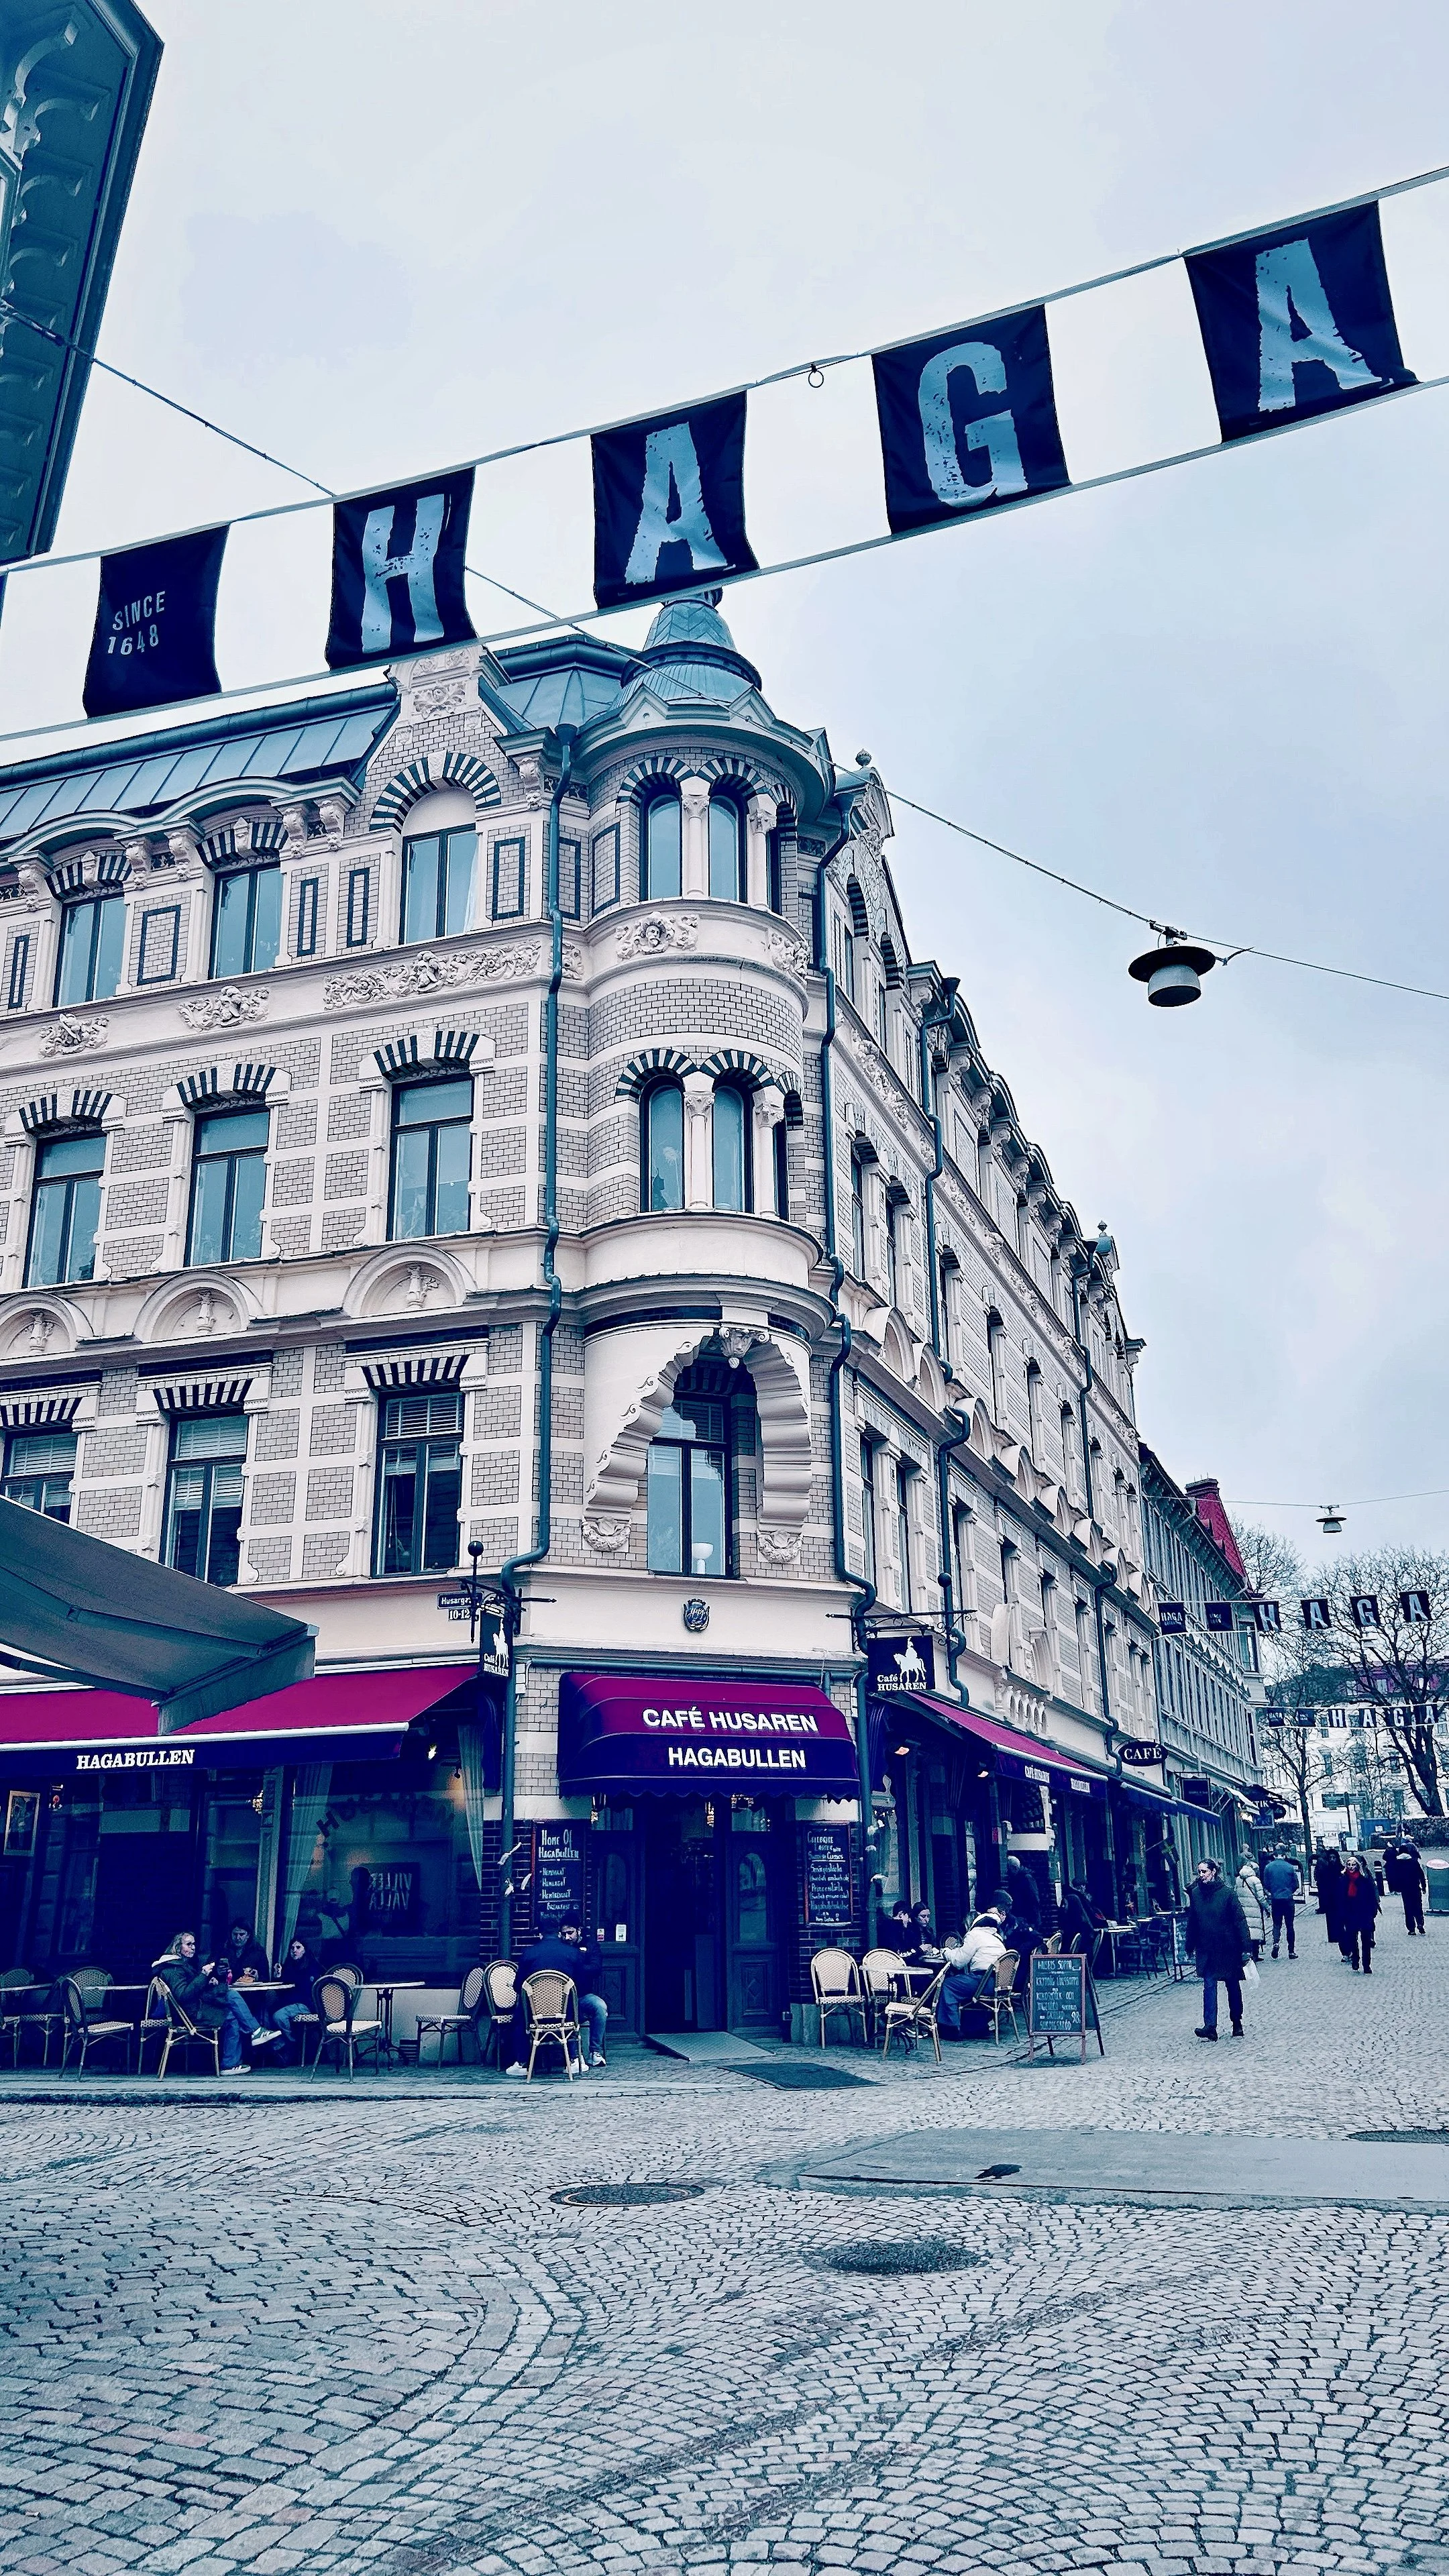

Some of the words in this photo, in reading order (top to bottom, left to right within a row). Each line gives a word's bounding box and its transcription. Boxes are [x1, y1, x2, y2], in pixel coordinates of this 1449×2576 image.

[113, 590, 166, 631] SINCE
[107, 624, 160, 656] 1648
[449, 1609, 470, 1620] 10-12
[877, 1673, 898, 1682] Café
[877, 1682, 926, 1691] HUSAREN
[643, 1706, 705, 1728] CAFÉ
[708, 1711, 818, 1732] HUSAREN
[76, 1750, 195, 1770] HAGABULLEN
[668, 1747, 806, 1768] HAGABULLEN
[1124, 1745, 1163, 1760] CAFÉ
